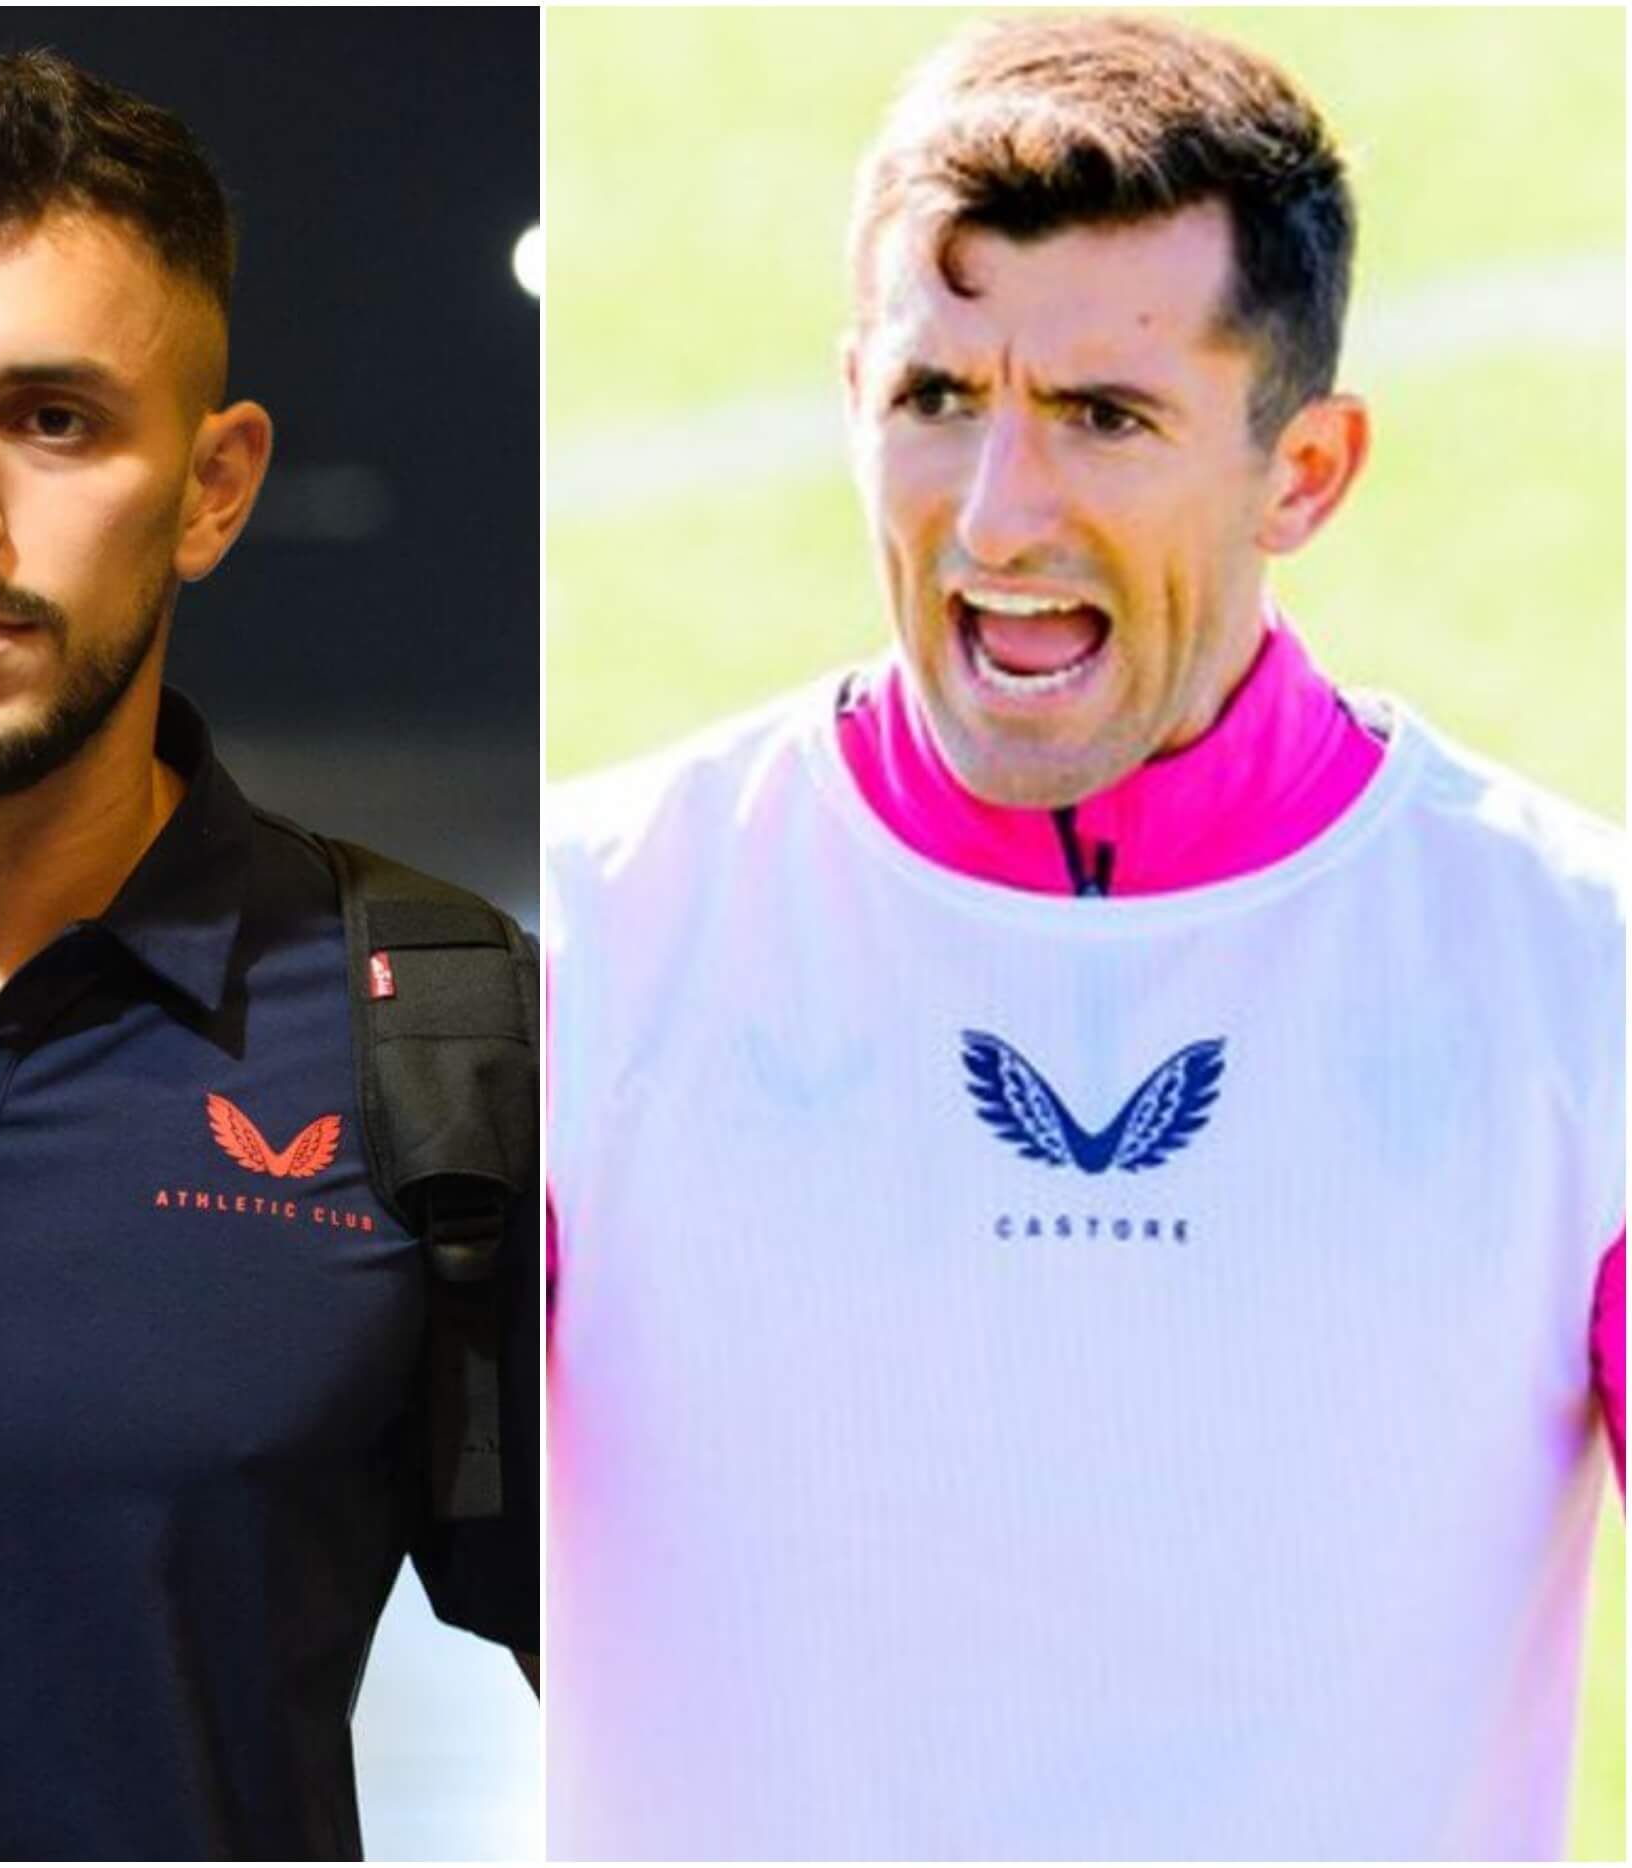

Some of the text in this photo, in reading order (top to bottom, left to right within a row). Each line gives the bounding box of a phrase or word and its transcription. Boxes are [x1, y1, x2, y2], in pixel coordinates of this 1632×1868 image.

[155, 1189, 374, 1231] ATHLETIC CLUB
[994, 1213, 1189, 1243] CASTORE
